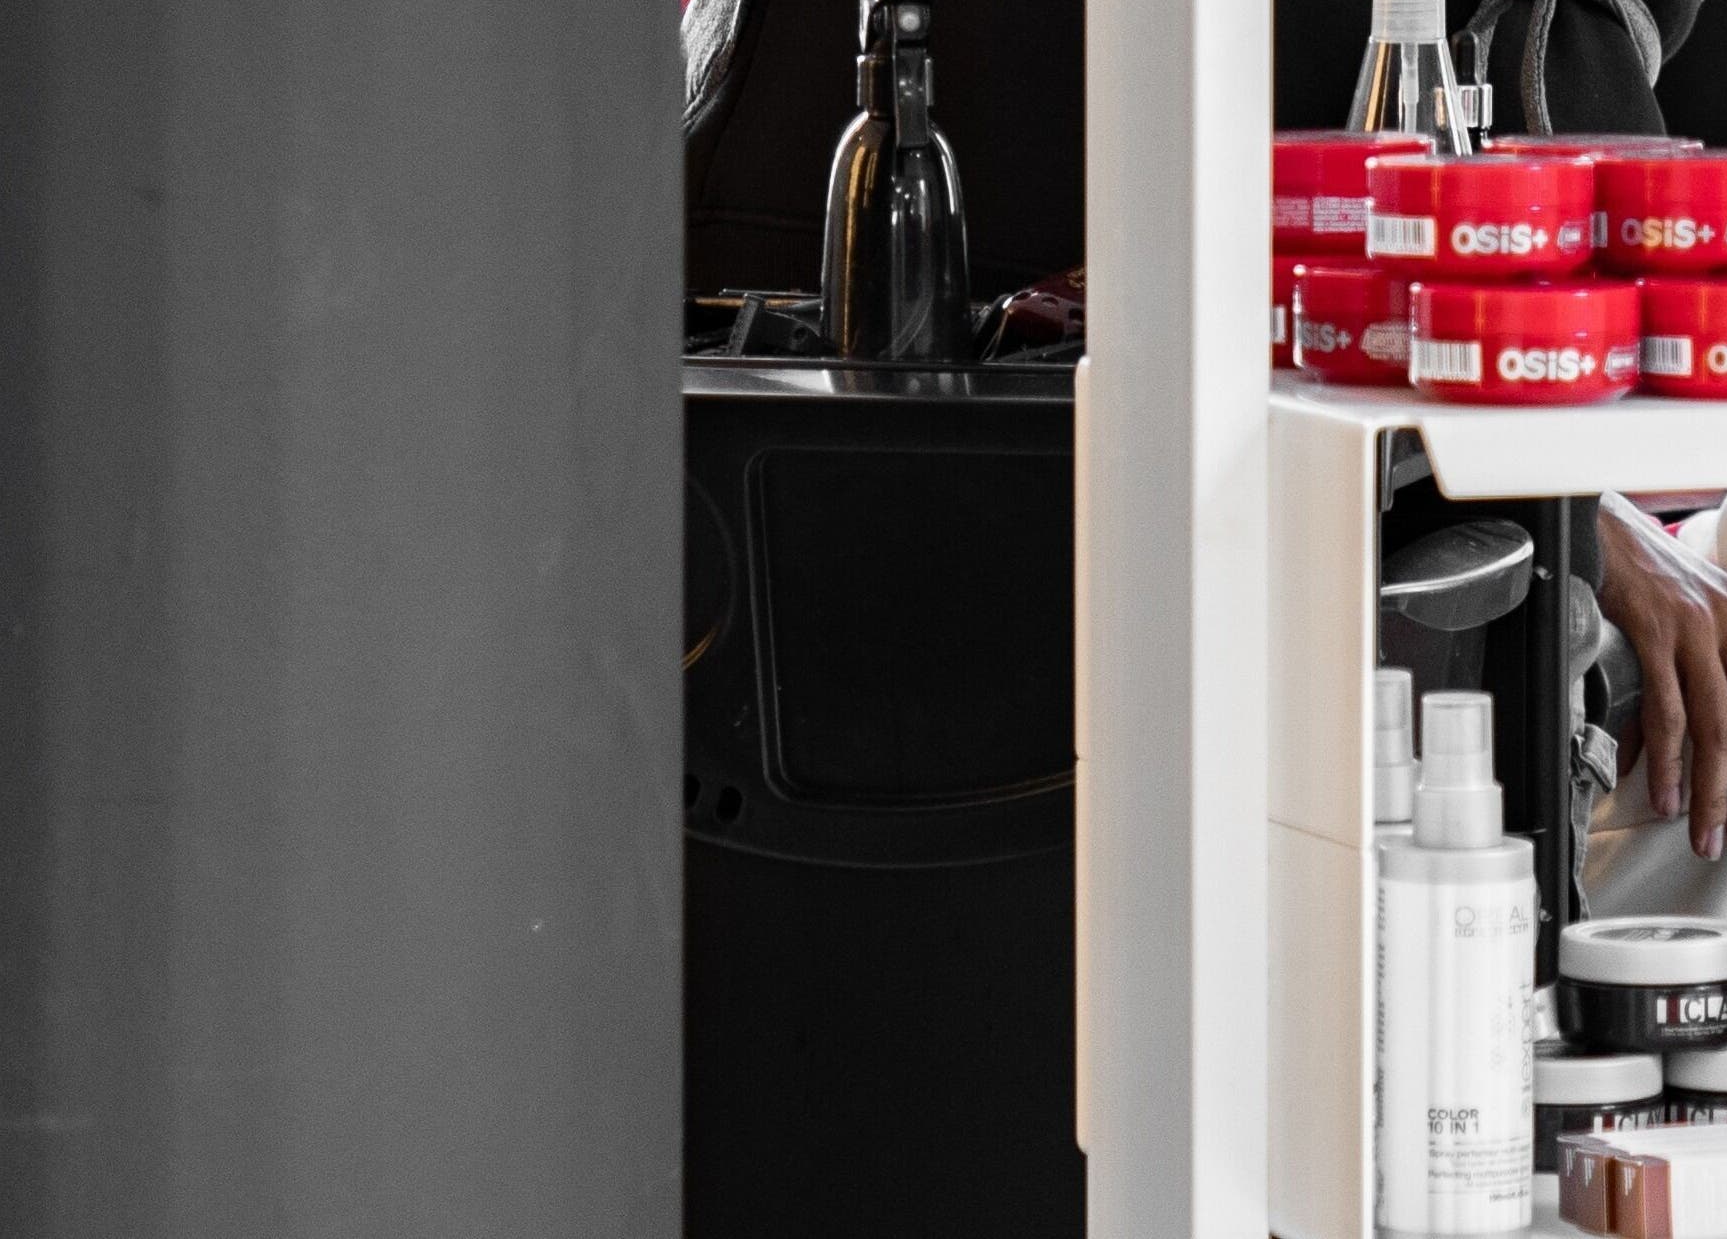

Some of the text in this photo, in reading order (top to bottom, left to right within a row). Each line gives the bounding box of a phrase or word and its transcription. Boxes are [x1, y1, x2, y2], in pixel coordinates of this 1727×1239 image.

[1427, 1108, 1480, 1121] COLOR
[1427, 1120, 1444, 1135] 10
[1450, 1120, 1467, 1135] IN
